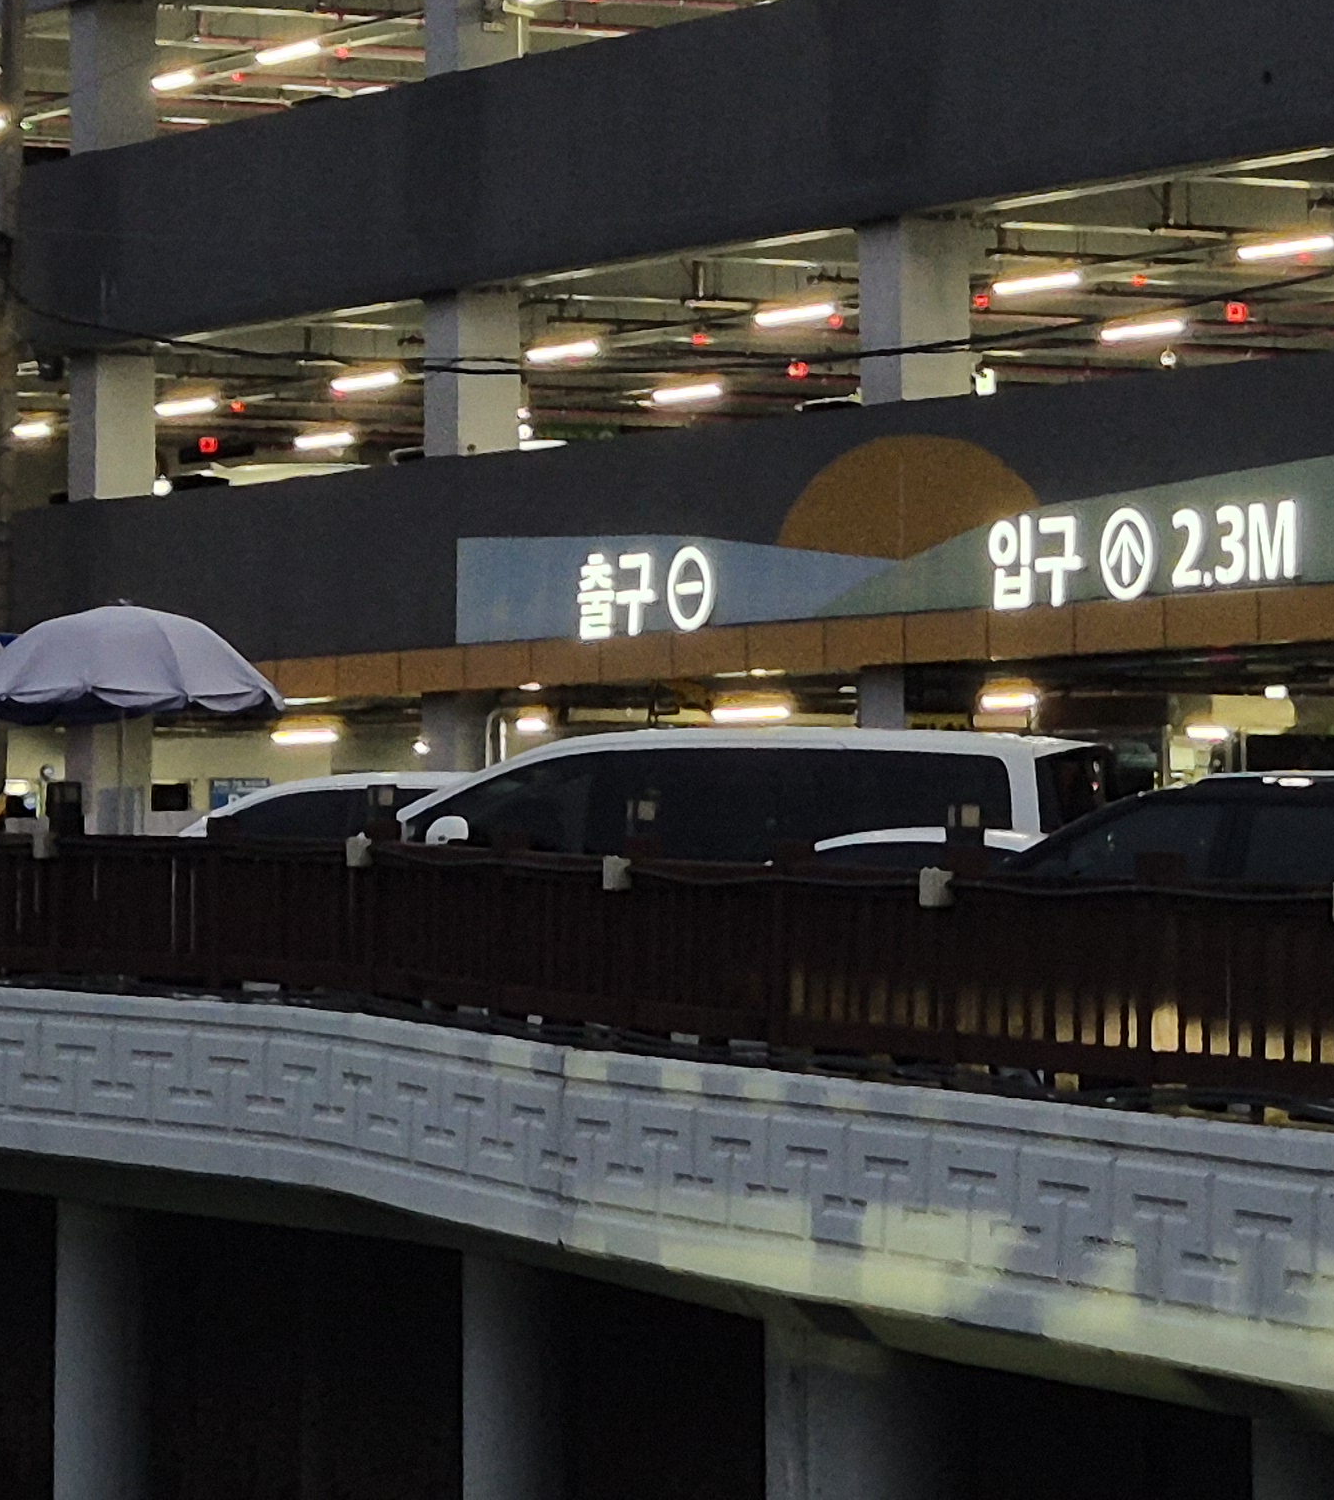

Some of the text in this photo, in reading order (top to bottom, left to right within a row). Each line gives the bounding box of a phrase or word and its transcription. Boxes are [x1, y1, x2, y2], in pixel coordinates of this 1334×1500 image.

[576, 552, 657, 641] 출구
[988, 497, 1299, 611] 입구 2.3M
